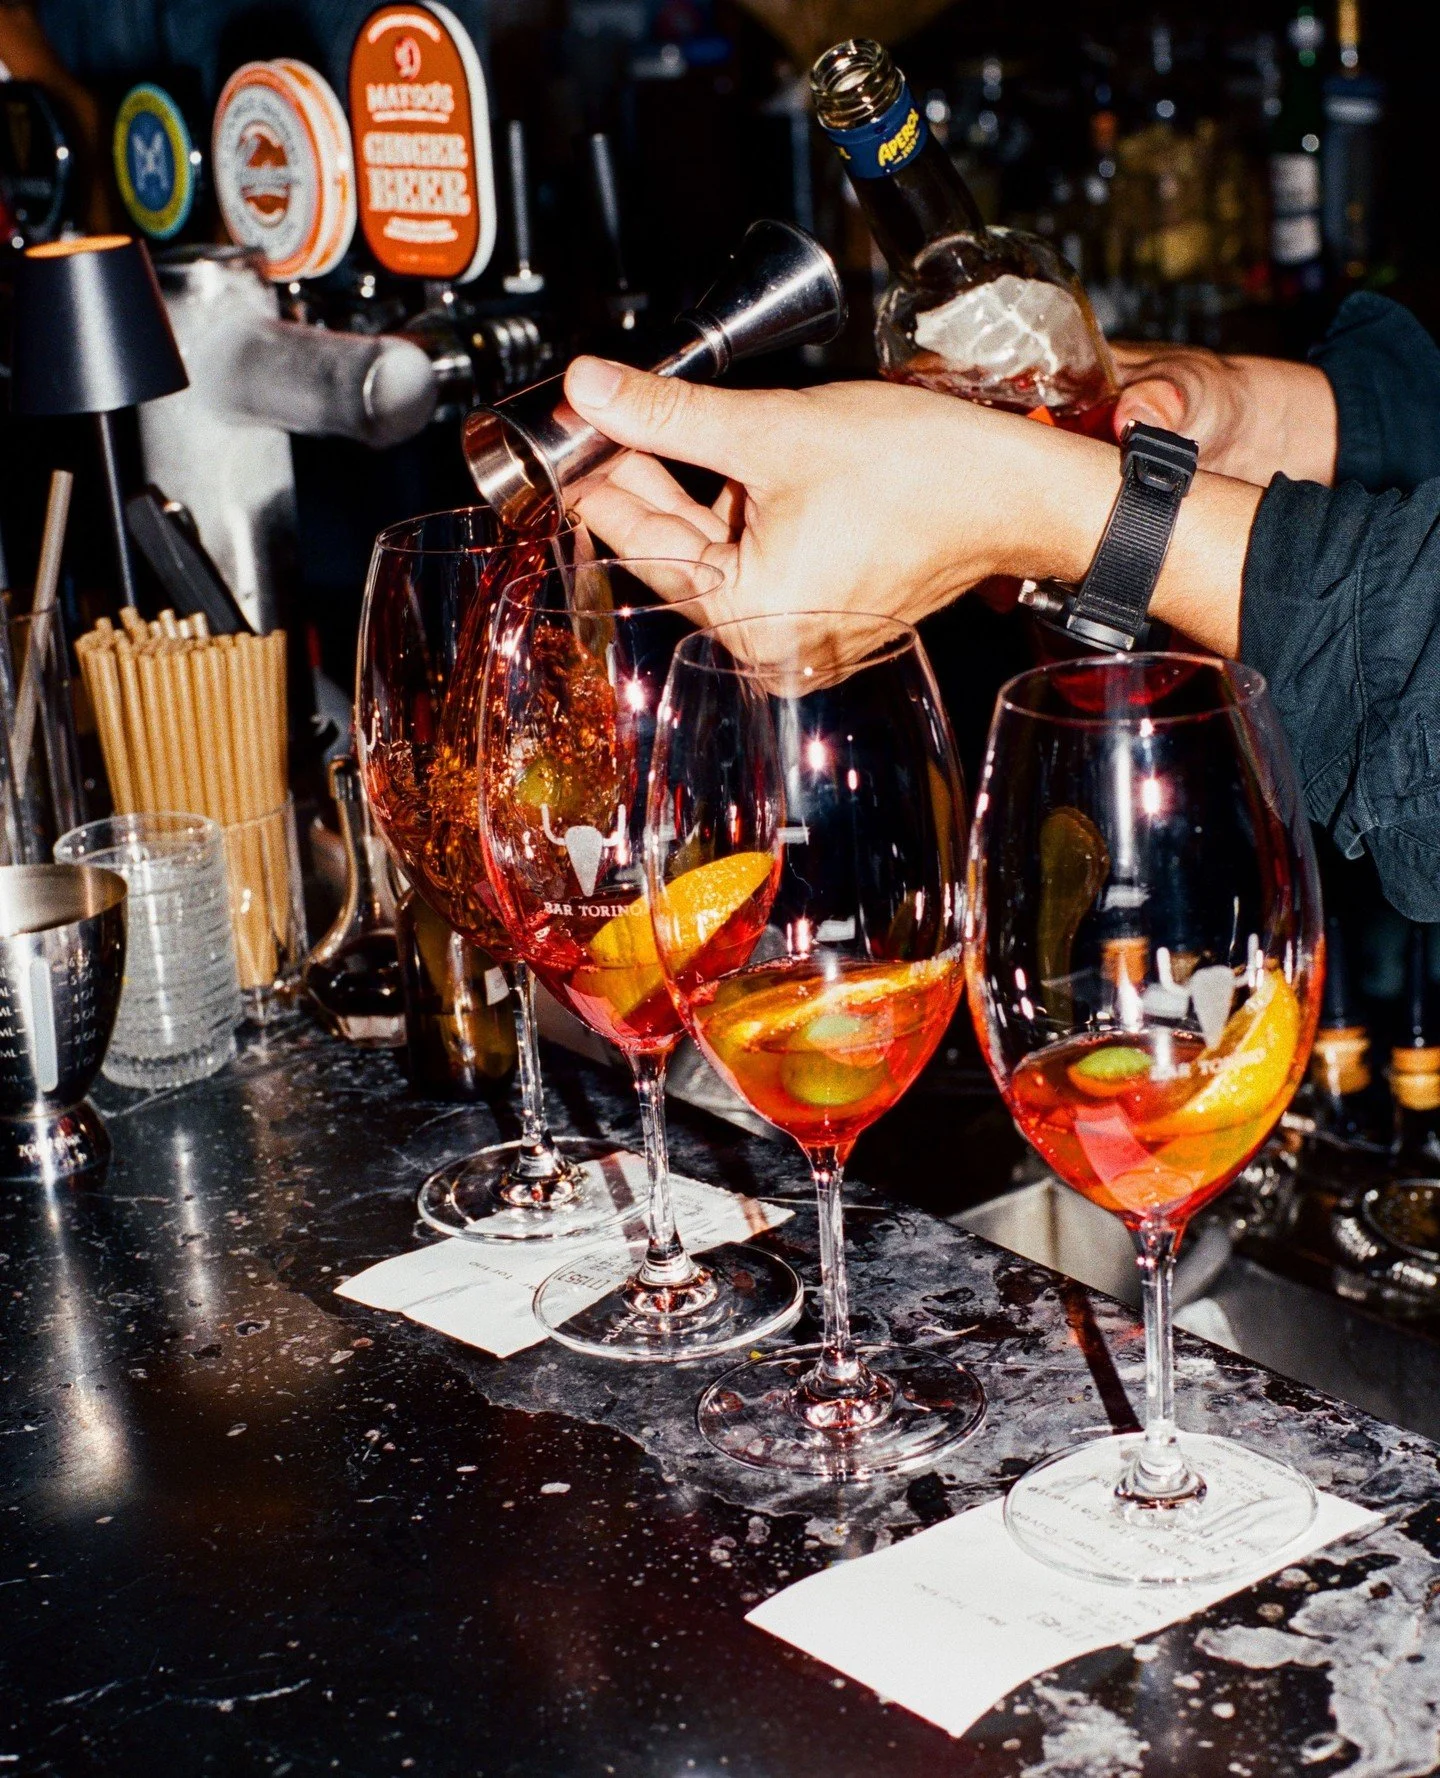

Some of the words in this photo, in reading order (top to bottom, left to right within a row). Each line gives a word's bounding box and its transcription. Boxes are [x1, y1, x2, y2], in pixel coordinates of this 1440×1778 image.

[363, 131, 468, 169] GINGER
[367, 166, 471, 216] BEER
[543, 902, 574, 917] BAR
[578, 904, 643, 918] TORINO
